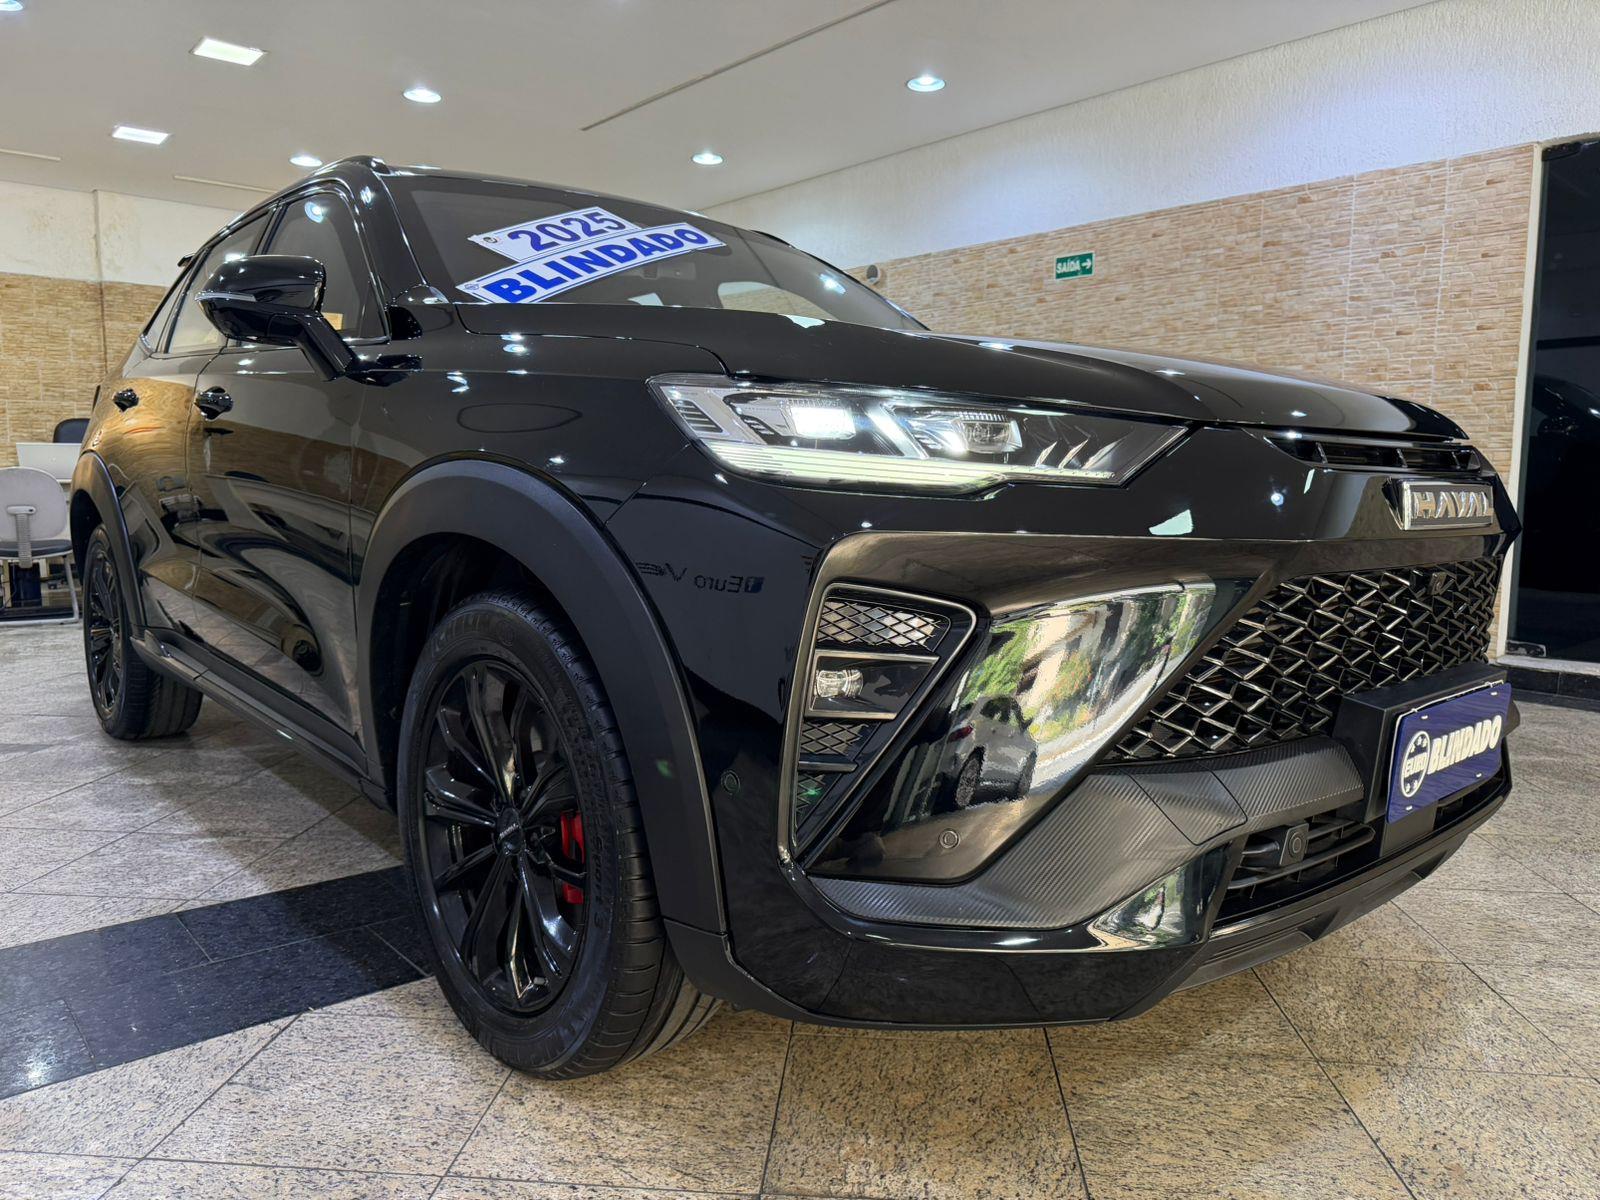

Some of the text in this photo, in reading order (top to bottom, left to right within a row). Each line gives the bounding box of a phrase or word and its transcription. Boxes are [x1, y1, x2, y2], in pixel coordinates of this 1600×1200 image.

[507, 212, 626, 251] 2025
[482, 228, 709, 303] BLINDADO
[1412, 491, 1494, 519] HAVAL
[1427, 715, 1502, 775] BLINDADO
